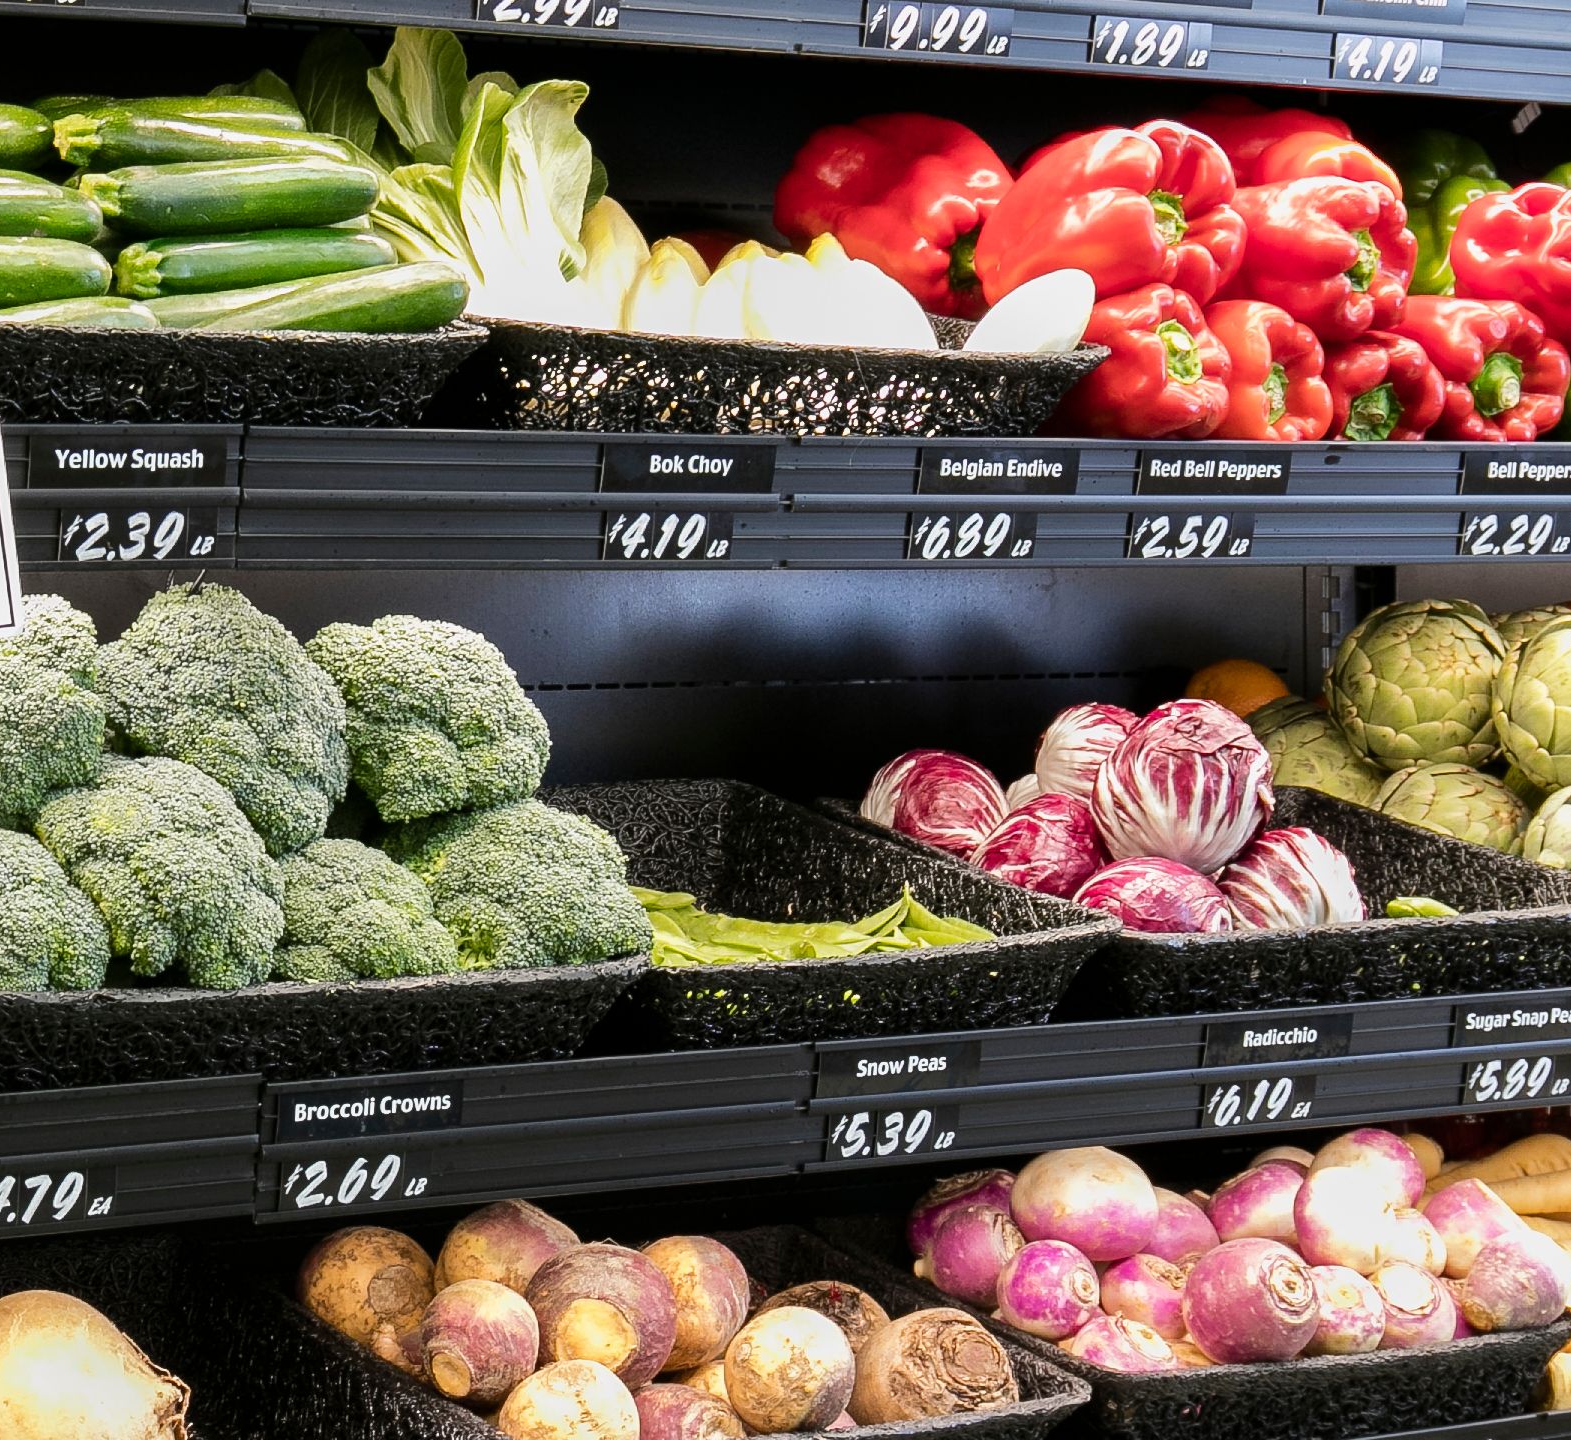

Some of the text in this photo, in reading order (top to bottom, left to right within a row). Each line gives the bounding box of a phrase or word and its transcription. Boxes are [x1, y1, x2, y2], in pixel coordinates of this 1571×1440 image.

[56, 449, 203, 472] Yellow Squash
[650, 454, 732, 477] Bok Choy
[940, 457, 1062, 482] Belgian Endive
[1150, 459, 1282, 481] Red Bell Peppers
[1488, 462, 1515, 479] Bell
[1466, 1011, 1507, 1032] Sugar
[1511, 1009, 1548, 1032] Snap
[1244, 1027, 1317, 1047] Radicchio
[857, 1054, 946, 1078] Snow Peas
[295, 1094, 451, 1122] Broccoli Crowns
